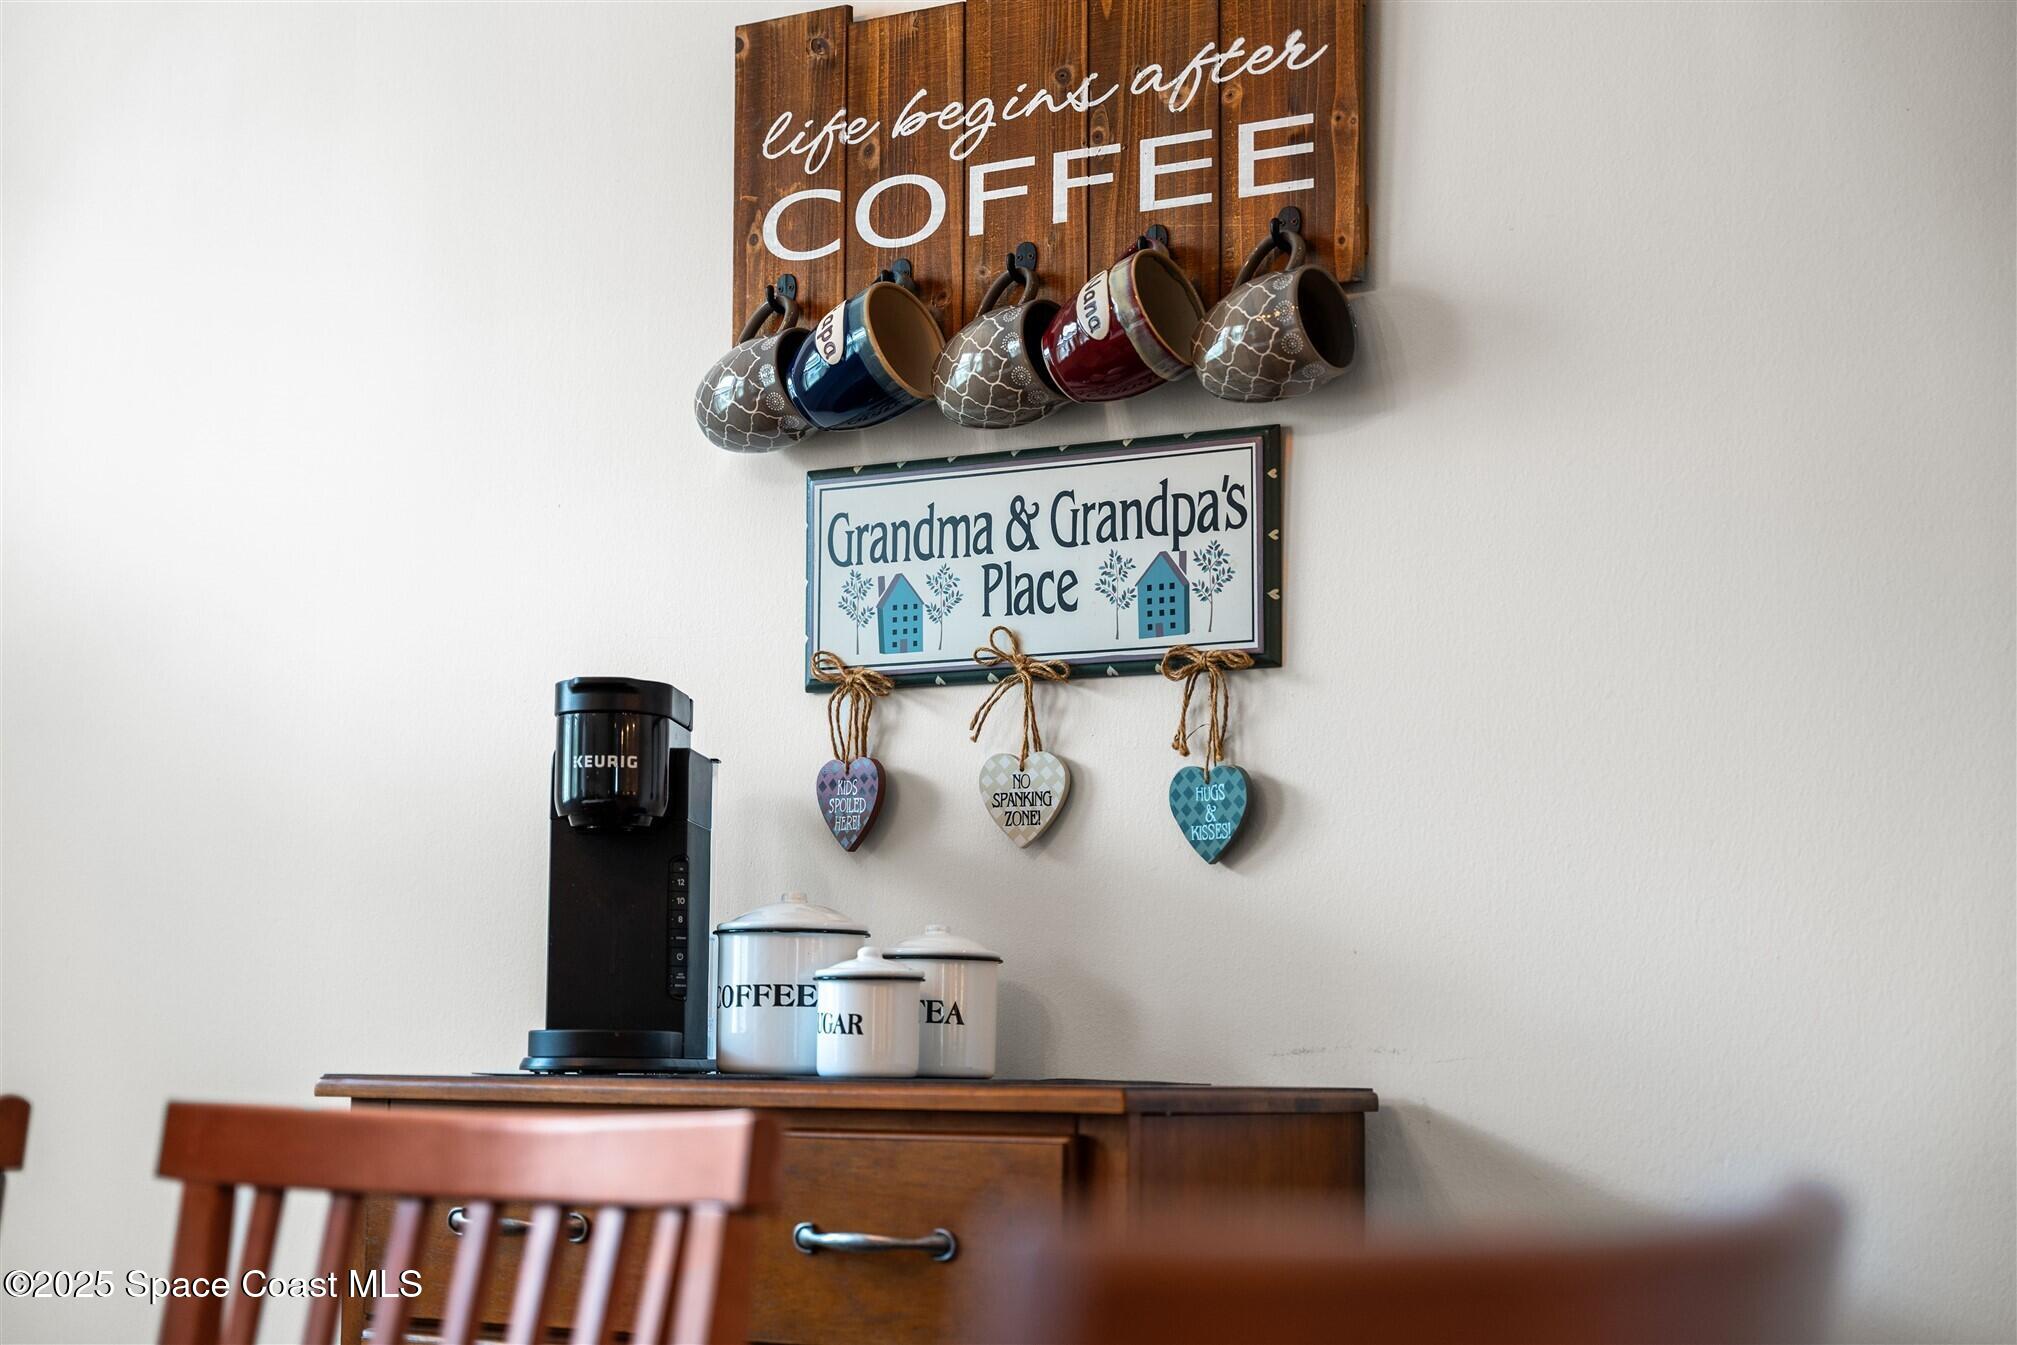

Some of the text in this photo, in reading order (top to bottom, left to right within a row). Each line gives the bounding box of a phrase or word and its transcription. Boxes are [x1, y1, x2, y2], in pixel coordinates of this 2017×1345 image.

[762, 29, 1328, 174] life begins after
[761, 113, 1314, 261] COFFEE
[817, 304, 842, 359] apa
[827, 474, 1248, 568] Grandma & Grandpa's
[981, 561, 1079, 618] Place
[573, 755, 638, 768] KEURIG
[837, 779, 858, 795] KIDS
[1012, 774, 1031, 789] NO
[992, 790, 1052, 808] SPANKING
[1195, 783, 1226, 802] HUGS
[829, 797, 867, 813] SPOILED
[1205, 804, 1217, 822] &
[834, 815, 860, 831] HERE!
[1004, 810, 1041, 827] ZONE!
[1191, 822, 1231, 840] KISSES!
[817, 1012, 864, 1035] UGAR
